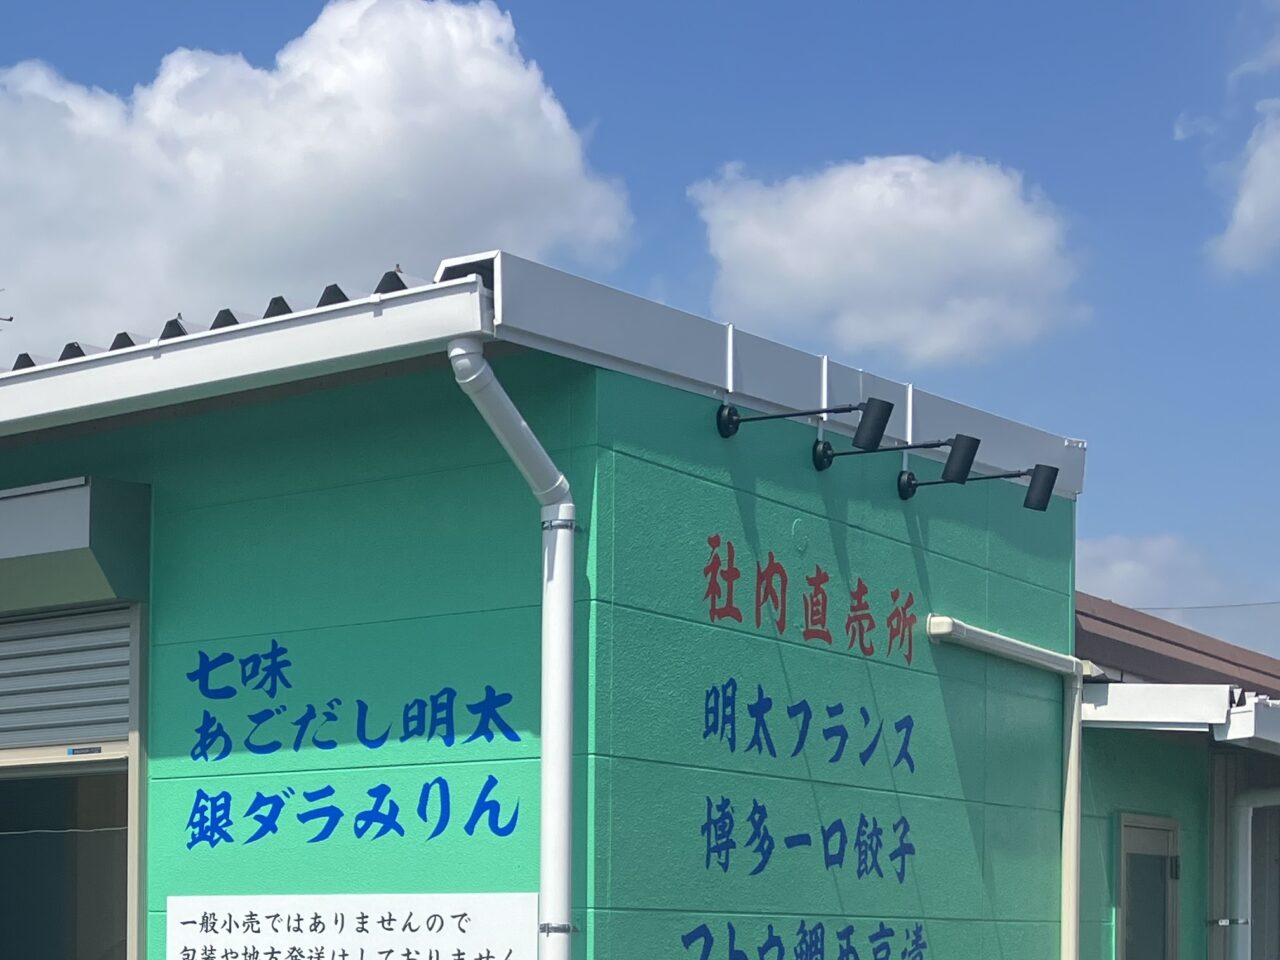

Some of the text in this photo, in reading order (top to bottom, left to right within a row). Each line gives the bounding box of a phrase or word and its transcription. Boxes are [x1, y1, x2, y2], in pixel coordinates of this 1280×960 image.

[703, 533, 918, 666] 社内直売所
[186, 639, 293, 700] 七味
[190, 684, 522, 762] あごだし明太
[702, 677, 916, 774] 明太フランス
[185, 774, 520, 850] 銀ダラみりん
[701, 796, 916, 885] 博多一口餃子
[180, 911, 472, 934] 一般小売ではありませんので
